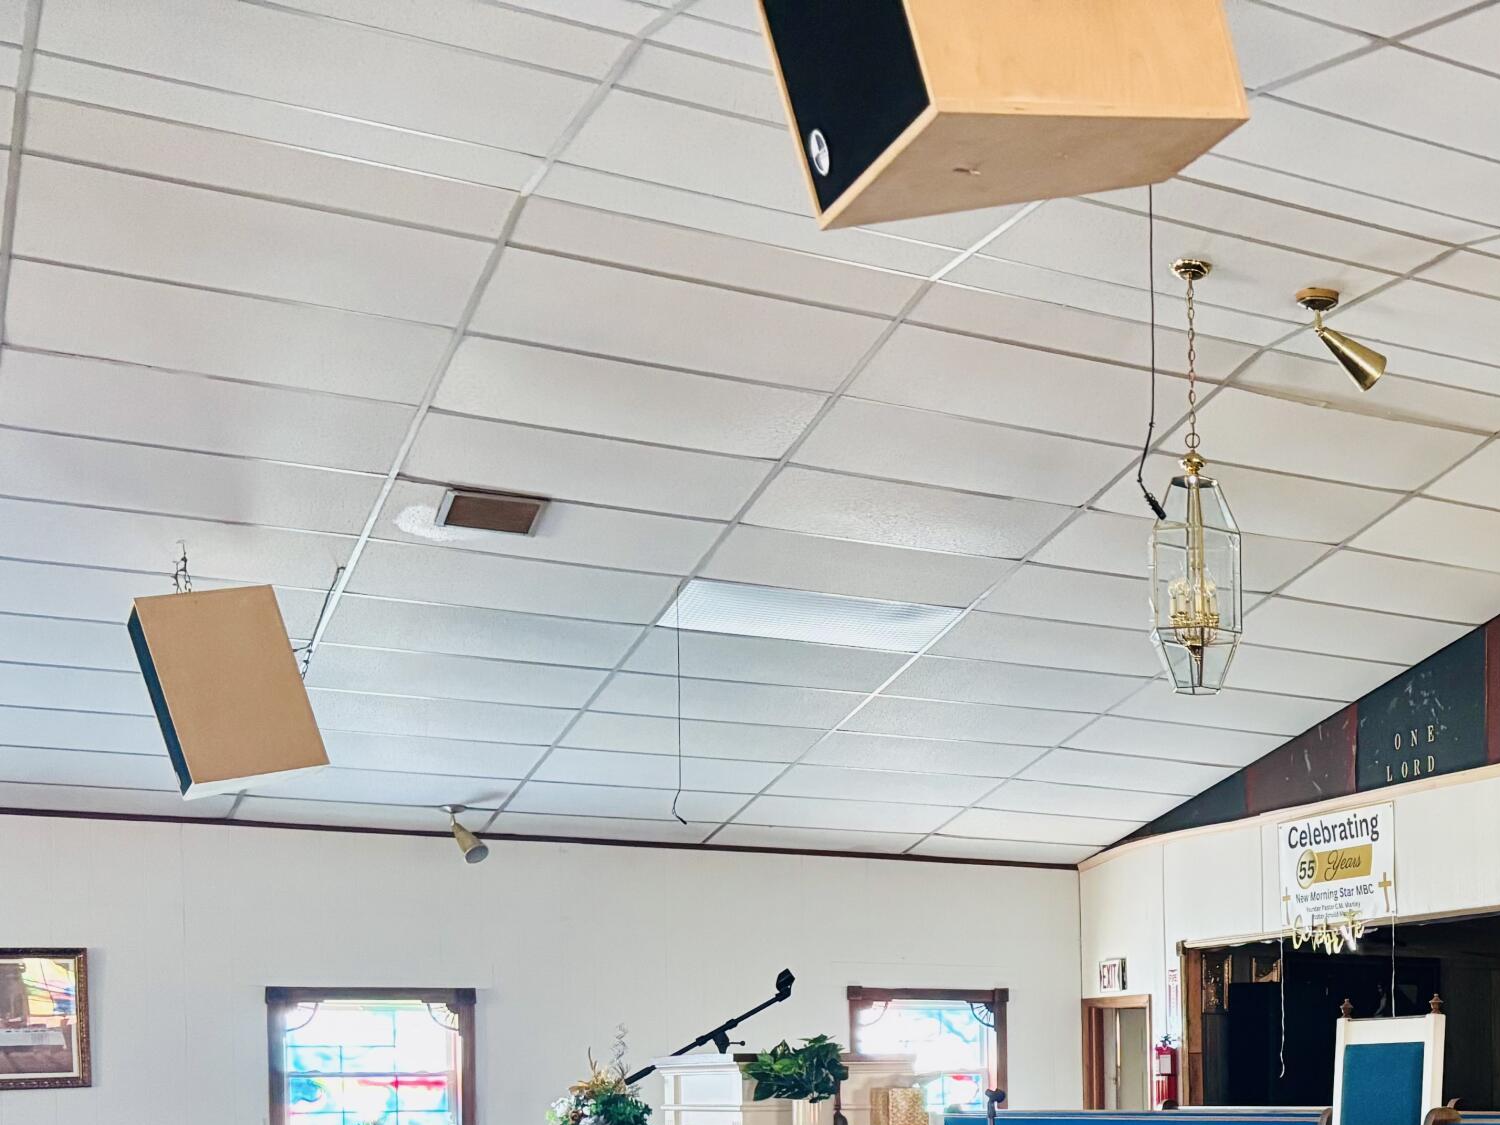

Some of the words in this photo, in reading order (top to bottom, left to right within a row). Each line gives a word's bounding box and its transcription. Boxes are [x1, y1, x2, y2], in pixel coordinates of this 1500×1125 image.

[1394, 725, 1435, 750] ONE
[1386, 755, 1435, 782] LORD
[1288, 813, 1380, 849] Celebrating
[1299, 860, 1316, 880] 55
[1324, 850, 1362, 882] Years
[1295, 893, 1309, 904] New
[1310, 889, 1338, 901] Morning
[1339, 886, 1354, 898] Star
[1355, 883, 1375, 896] MBC
[1102, 963, 1117, 989] EXIT
